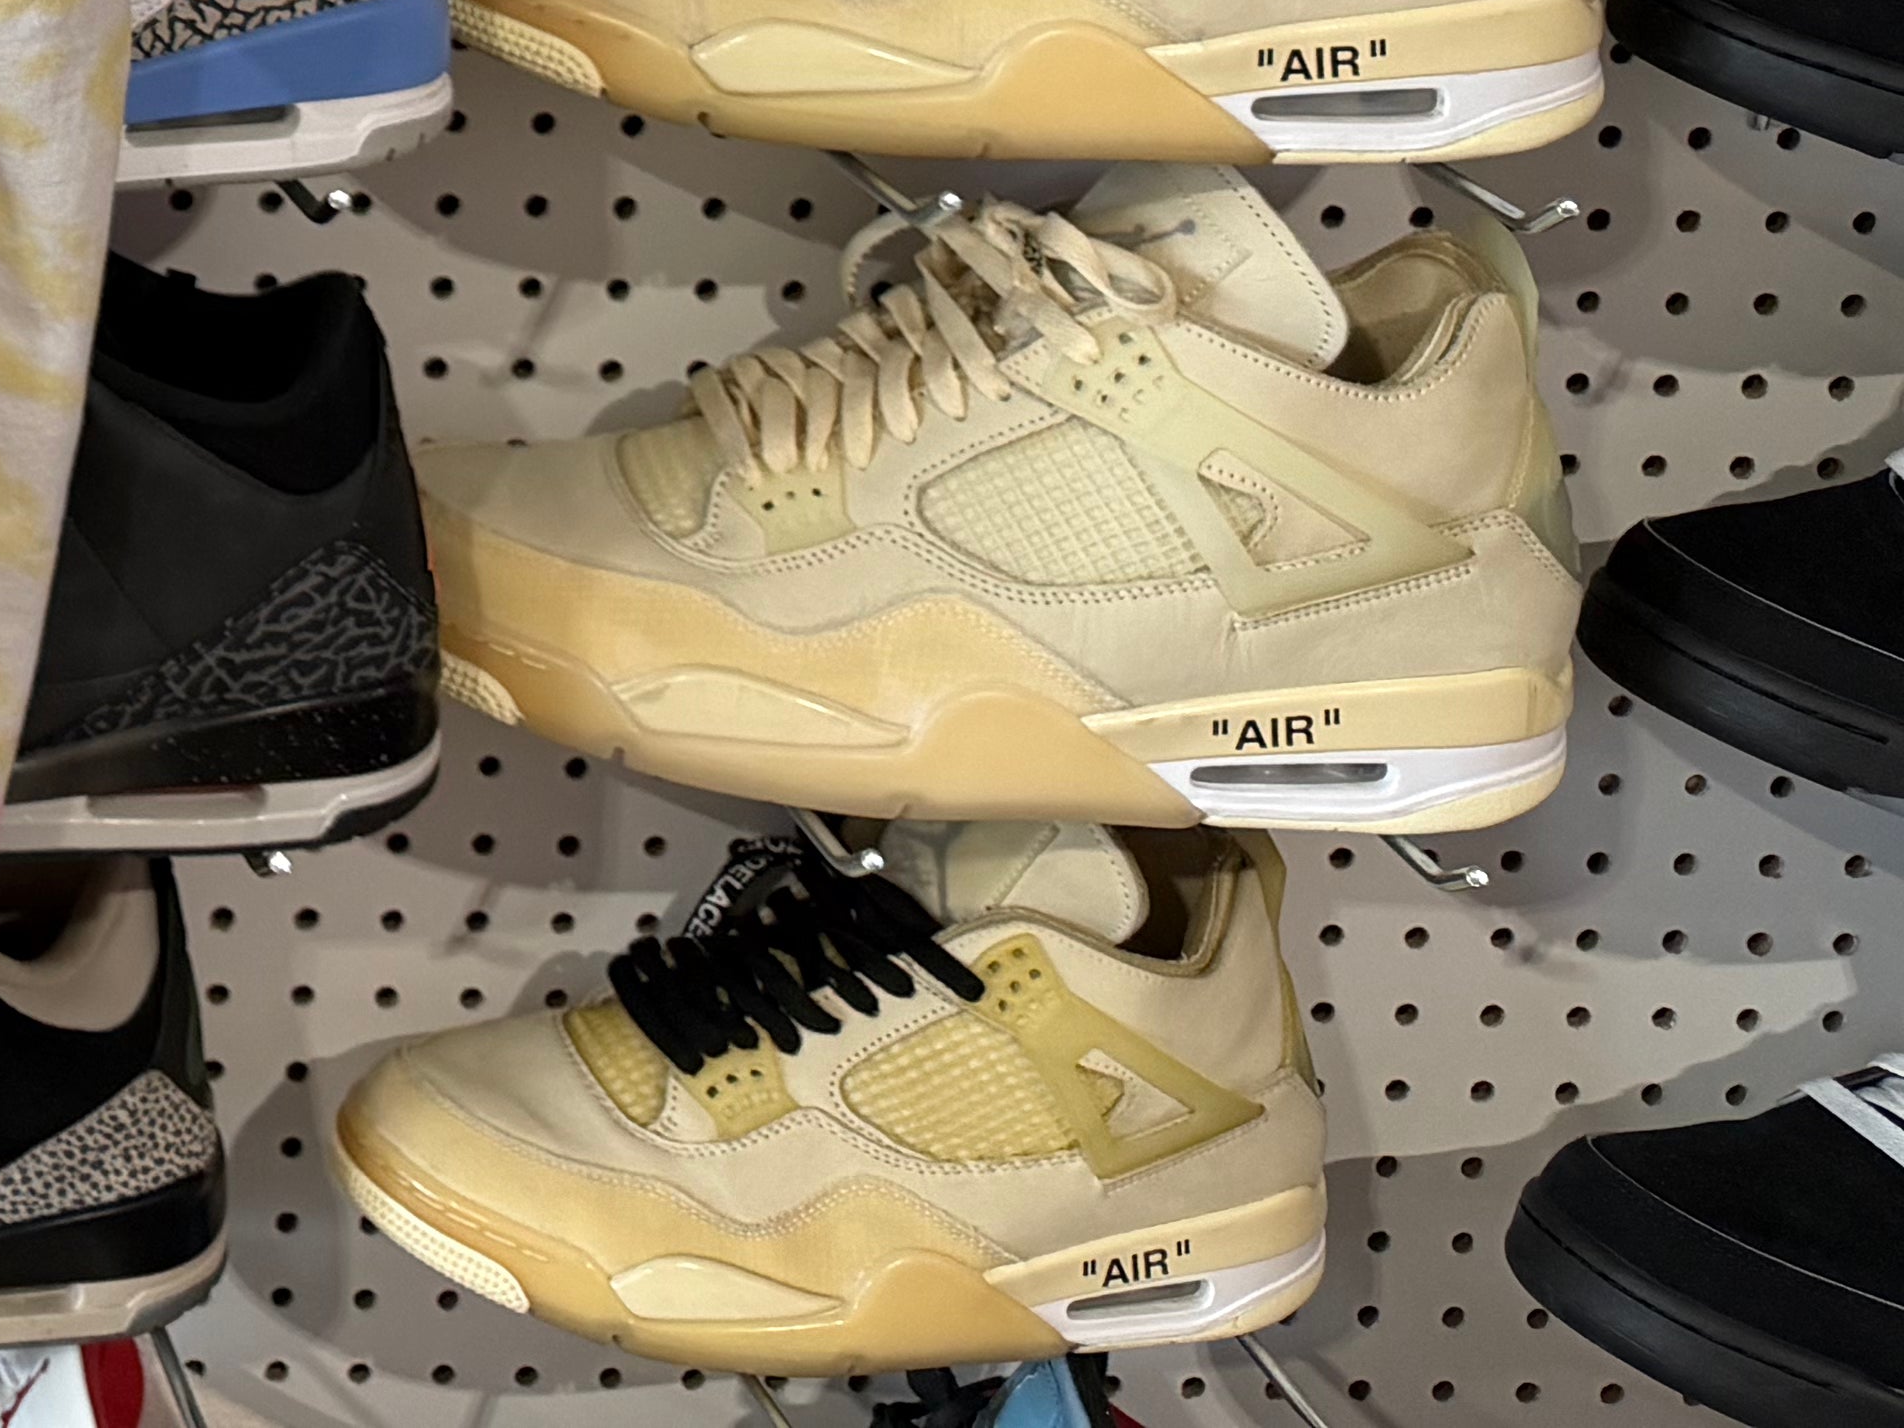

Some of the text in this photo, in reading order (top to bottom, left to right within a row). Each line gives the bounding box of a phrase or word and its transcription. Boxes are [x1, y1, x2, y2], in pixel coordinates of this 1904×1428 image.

[1258, 39, 1387, 82] "AIR"
[1212, 709, 1340, 751] "AIR"
[1082, 1239, 1190, 1288] "AIR"
